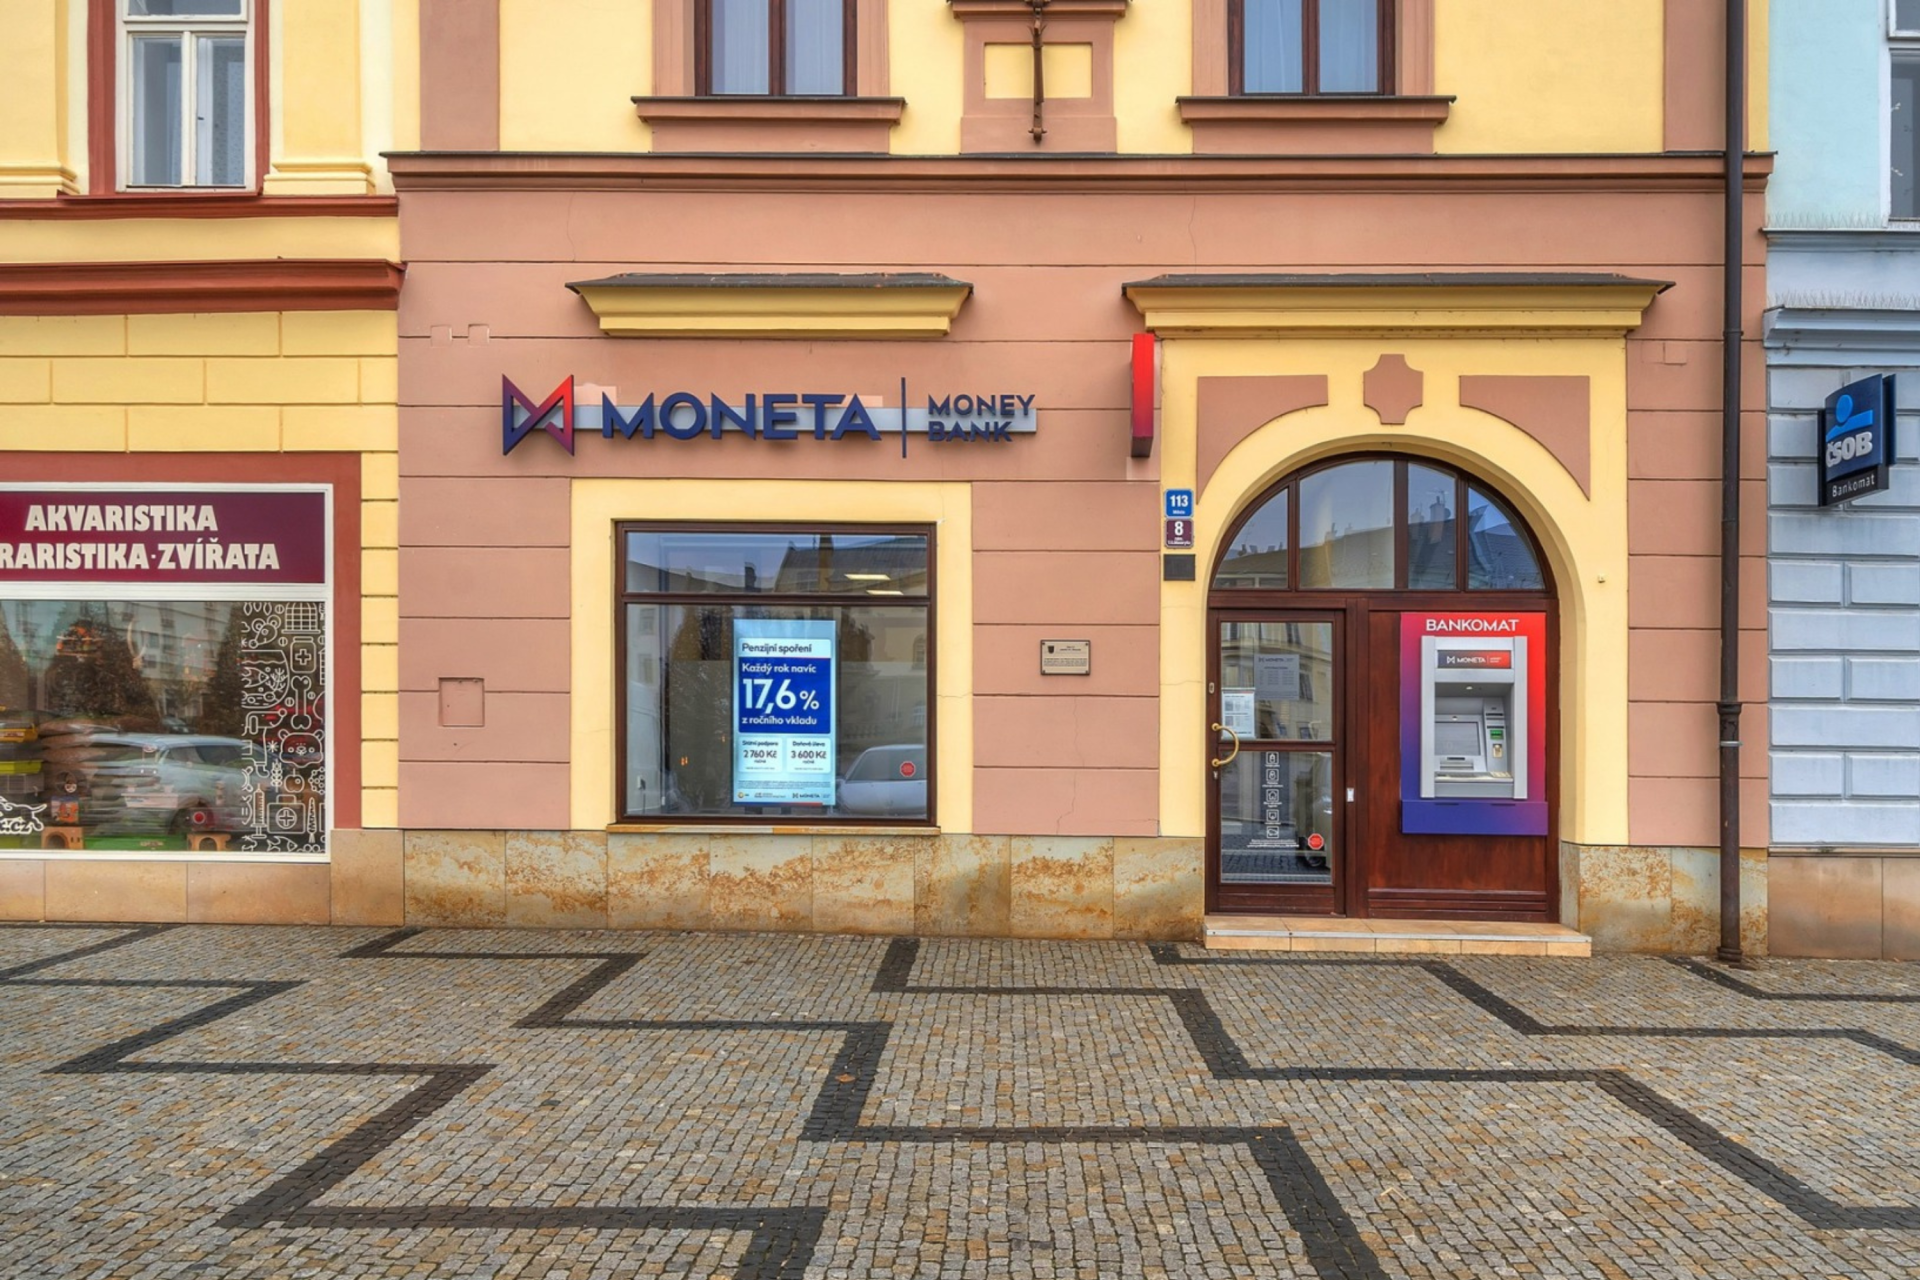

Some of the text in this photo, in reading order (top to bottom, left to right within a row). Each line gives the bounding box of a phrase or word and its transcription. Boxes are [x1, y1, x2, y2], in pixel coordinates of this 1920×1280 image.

[927, 393, 1036, 416] MONEY
[602, 391, 883, 441] MONETA
[927, 420, 1013, 442] BANK
[1825, 431, 1873, 468] ČSOB
[1832, 474, 1876, 498] Bankomat
[1170, 494, 1189, 508] 113
[24, 505, 219, 532] AKVARISTIKA
[1174, 520, 1184, 536] 8
[157, 537, 281, 570] ZVÍŘATA
[1425, 618, 1520, 632] BANKOMAT
[741, 643, 812, 655] Penzijní spoření
[1456, 656, 1486, 664] MONETA
[741, 663, 817, 675] Každý rok navíc
[742, 678, 820, 714] 17,6 %
[749, 715, 784, 725] ročního
[784, 715, 817, 725] vkladu
[743, 749, 778, 759] 2 760 Kč
[790, 750, 797, 759] 3
[797, 750, 815, 759] 600
